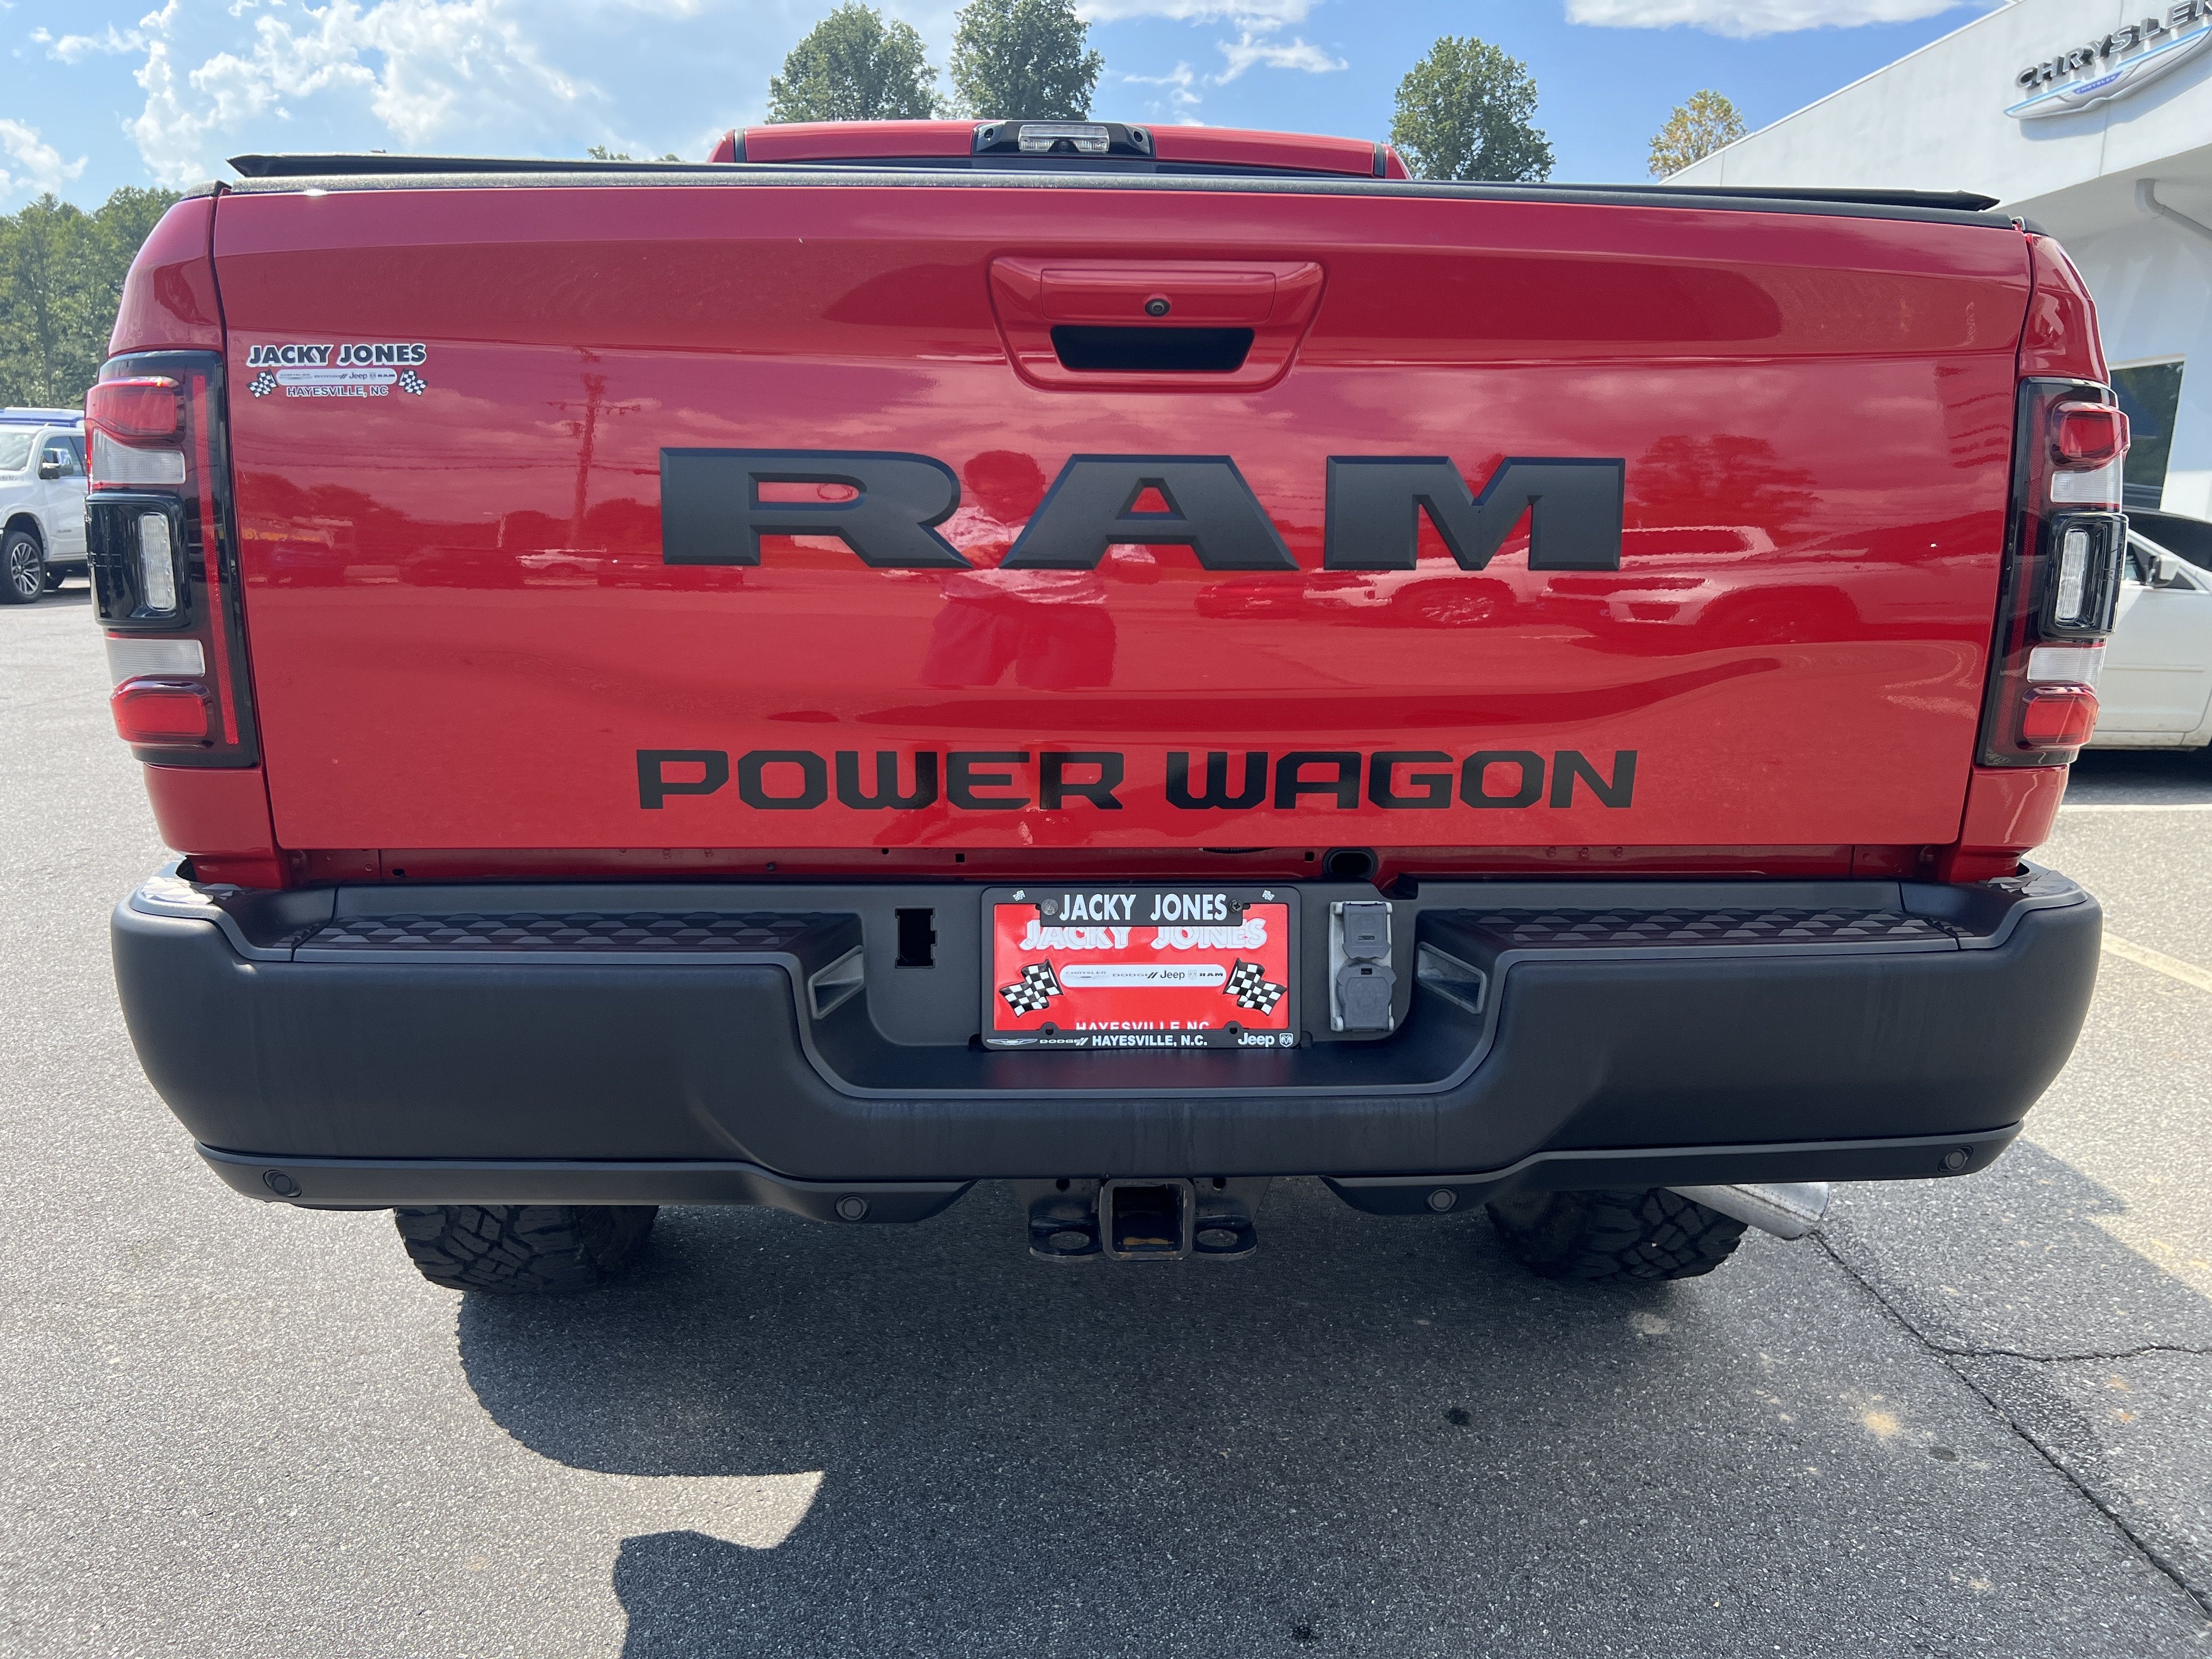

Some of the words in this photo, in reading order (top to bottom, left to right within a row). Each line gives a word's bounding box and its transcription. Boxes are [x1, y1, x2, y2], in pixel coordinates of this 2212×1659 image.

[246, 344, 334, 367] JACKY
[336, 343, 426, 366] JONES
[287, 386, 368, 397] HAYESVILLE,
[371, 386, 389, 396] NC
[660, 448, 1626, 571] RAM
[636, 749, 1124, 810] POWER
[1166, 751, 1638, 809] WAGON
[1059, 894, 1136, 921] JACKY
[1150, 894, 1227, 921] JONES
[1019, 918, 1132, 950] JACKY
[1150, 918, 1267, 950] JONES
[1160, 970, 1185, 980] Jeep
[1092, 1035, 1177, 1047] HAYESVILLE,
[1181, 1035, 1207, 1046] N.C.
[1238, 1032, 1275, 1047] Jeep
